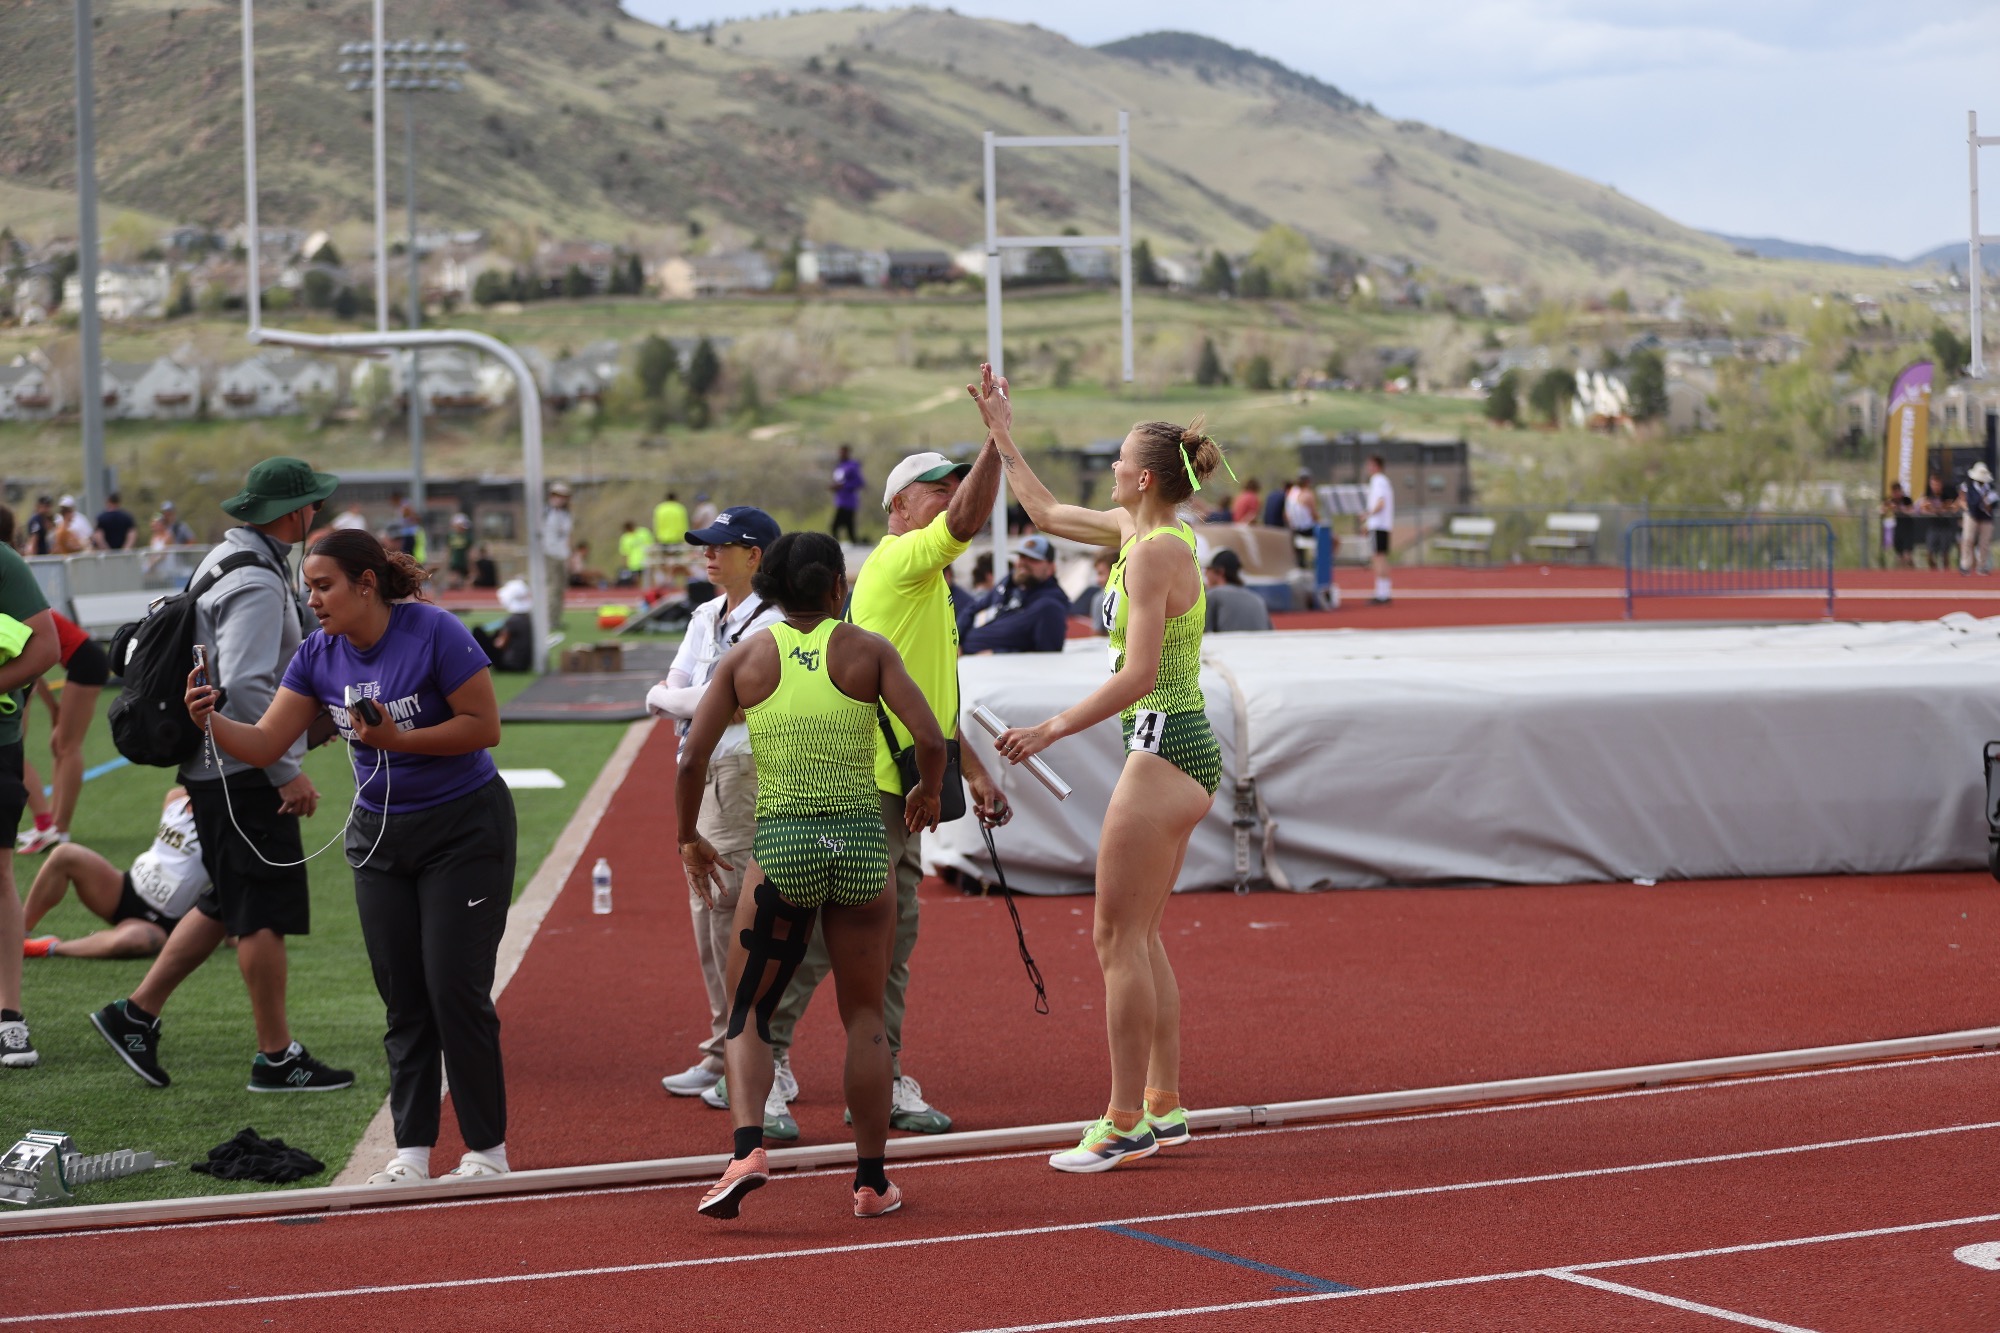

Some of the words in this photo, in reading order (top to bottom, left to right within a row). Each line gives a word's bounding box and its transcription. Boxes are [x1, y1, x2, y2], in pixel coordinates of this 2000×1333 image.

[1103, 590, 1116, 627] 4
[788, 646, 820, 671] ASU
[385, 693, 422, 722] UNITY
[1136, 713, 1158, 749] 4
[817, 835, 846, 853] ASU
